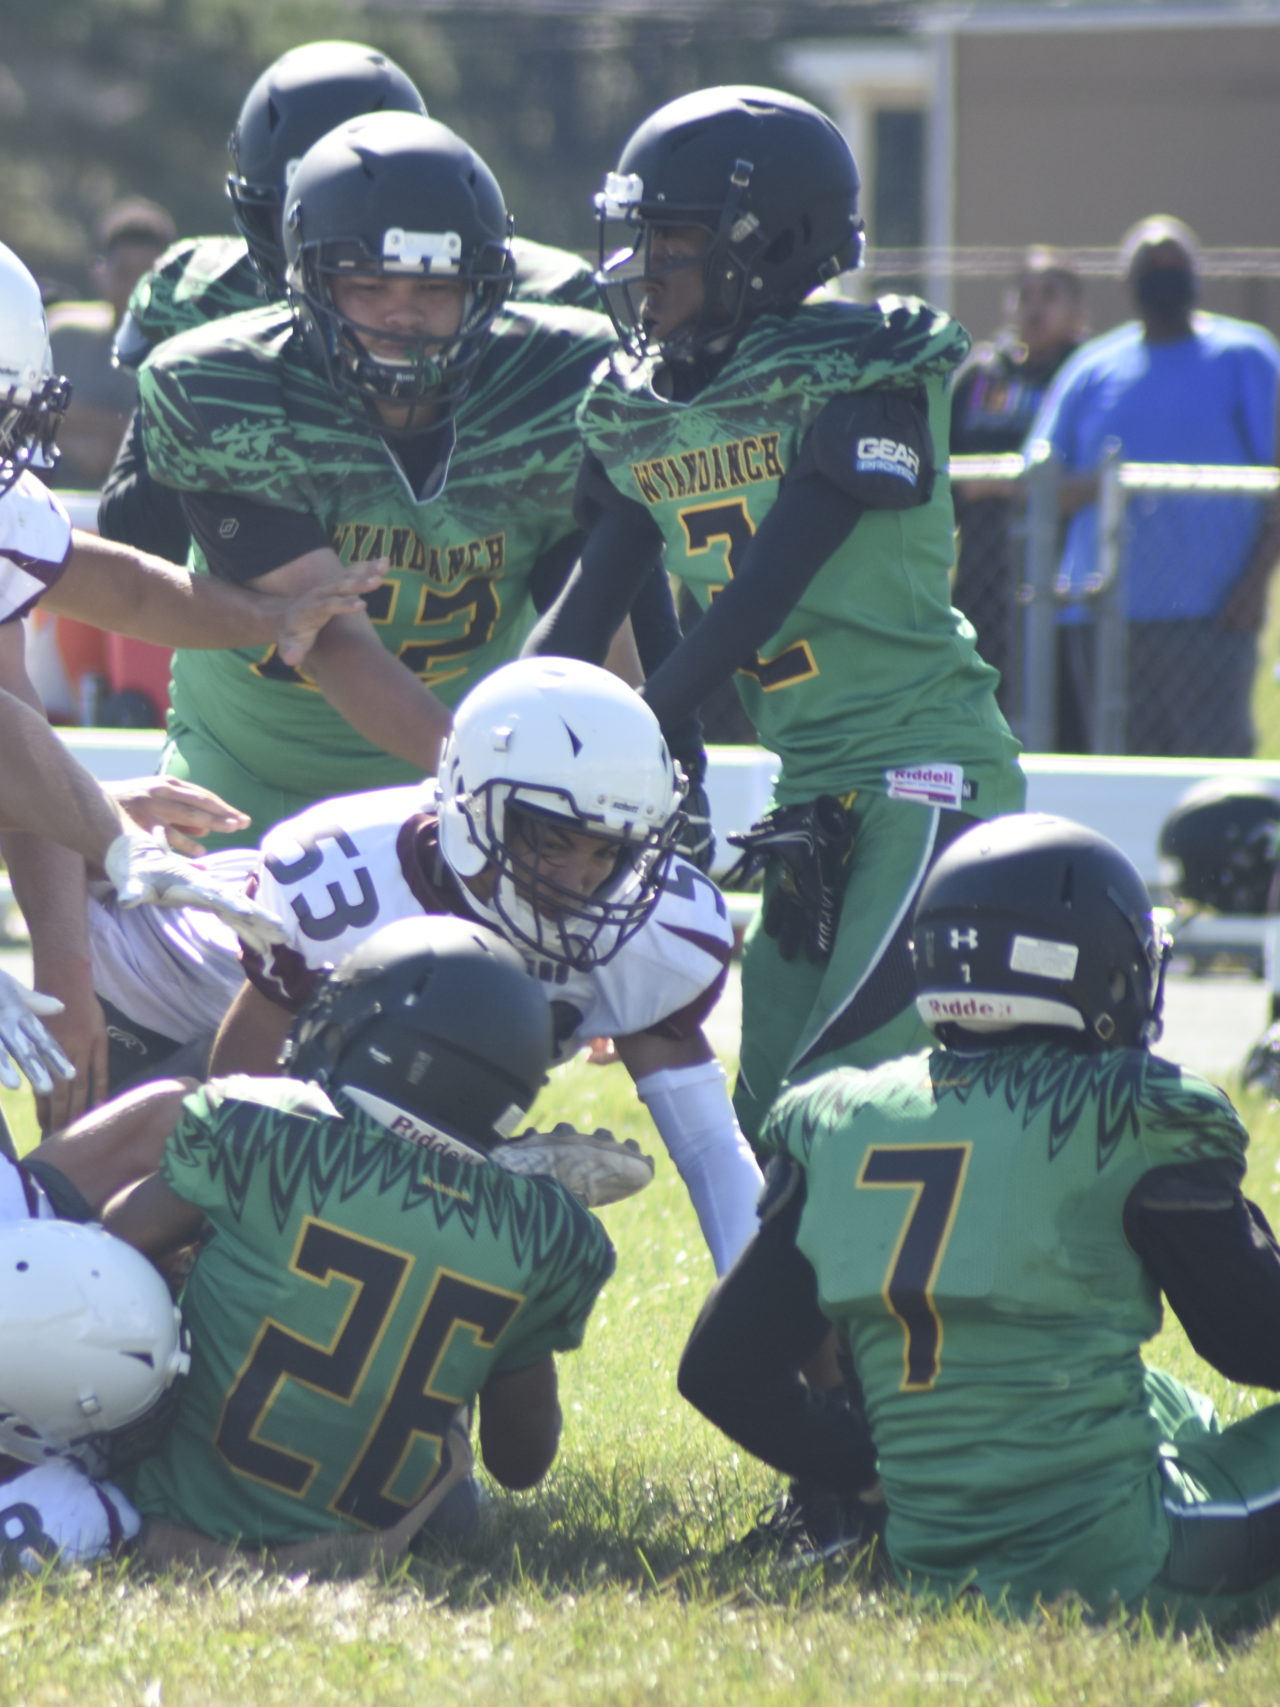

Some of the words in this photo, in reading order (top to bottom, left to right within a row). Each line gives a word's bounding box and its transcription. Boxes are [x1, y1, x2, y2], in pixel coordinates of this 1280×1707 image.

[632, 433, 786, 504] WYANDANCH
[857, 436, 920, 475] GEAR
[263, 825, 380, 942] 53
[855, 1141, 973, 1391] 7
[213, 1214, 526, 1532] 26
